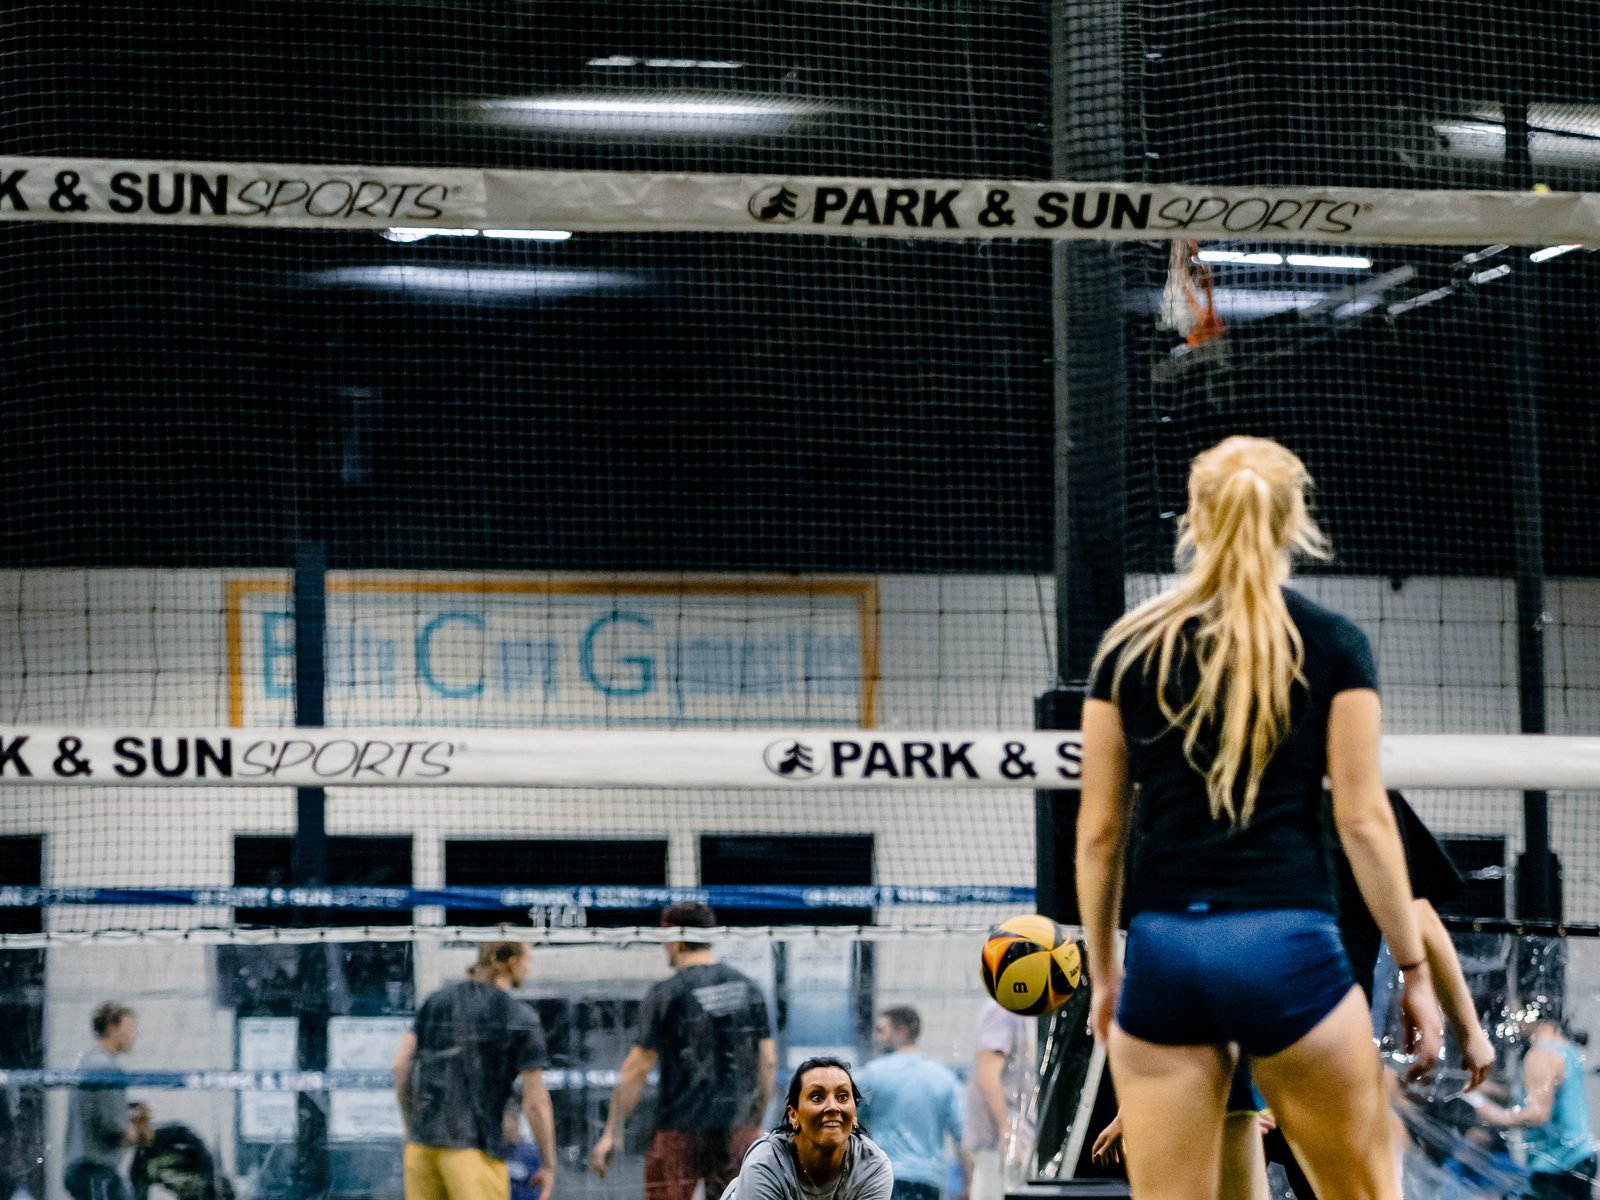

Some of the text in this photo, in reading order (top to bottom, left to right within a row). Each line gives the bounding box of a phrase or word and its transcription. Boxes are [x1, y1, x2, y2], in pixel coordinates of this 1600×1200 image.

[48, 170, 89, 212] &
[812, 186, 961, 228] PARK
[977, 188, 1016, 228] &
[52, 735, 93, 777] &
[830, 740, 981, 779] PARK
[999, 740, 1038, 779] &
